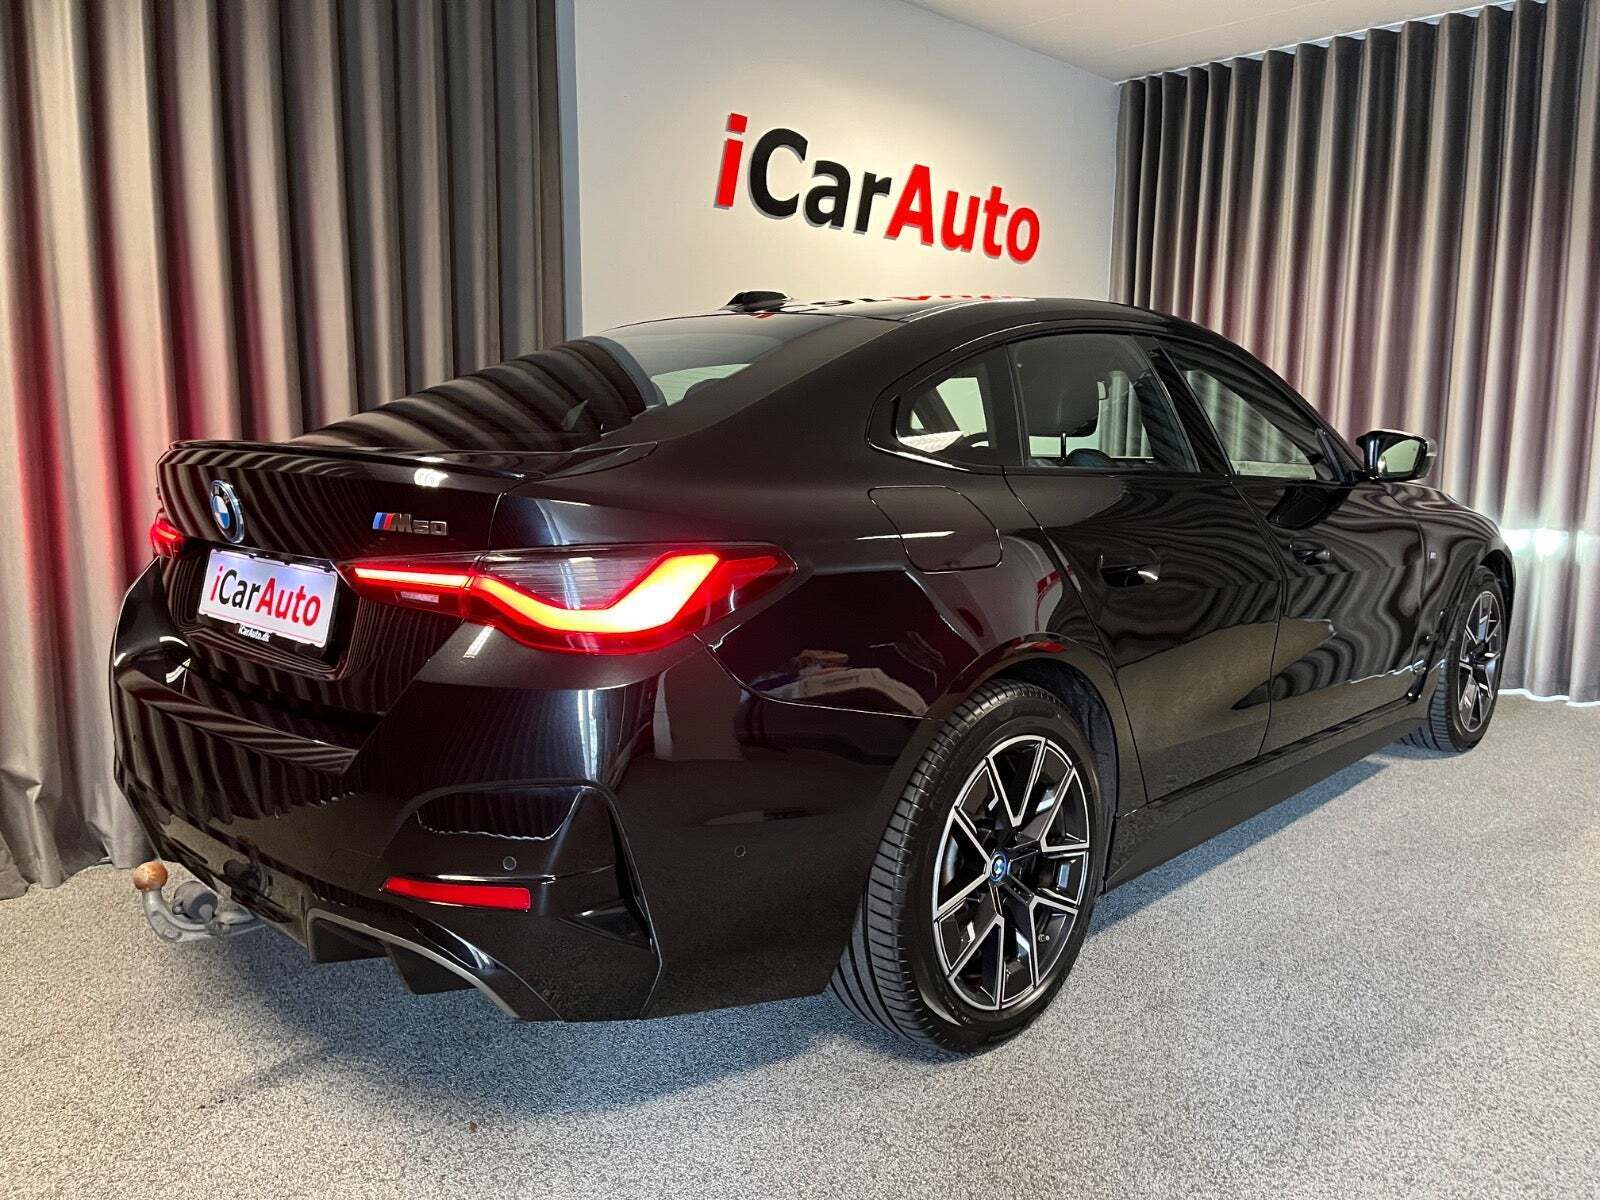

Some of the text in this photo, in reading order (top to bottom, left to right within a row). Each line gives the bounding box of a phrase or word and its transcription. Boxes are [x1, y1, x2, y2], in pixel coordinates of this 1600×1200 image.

[714, 112, 1041, 263] iCarAuto
[388, 512, 447, 536] M50
[210, 565, 322, 627] iCarAuto
